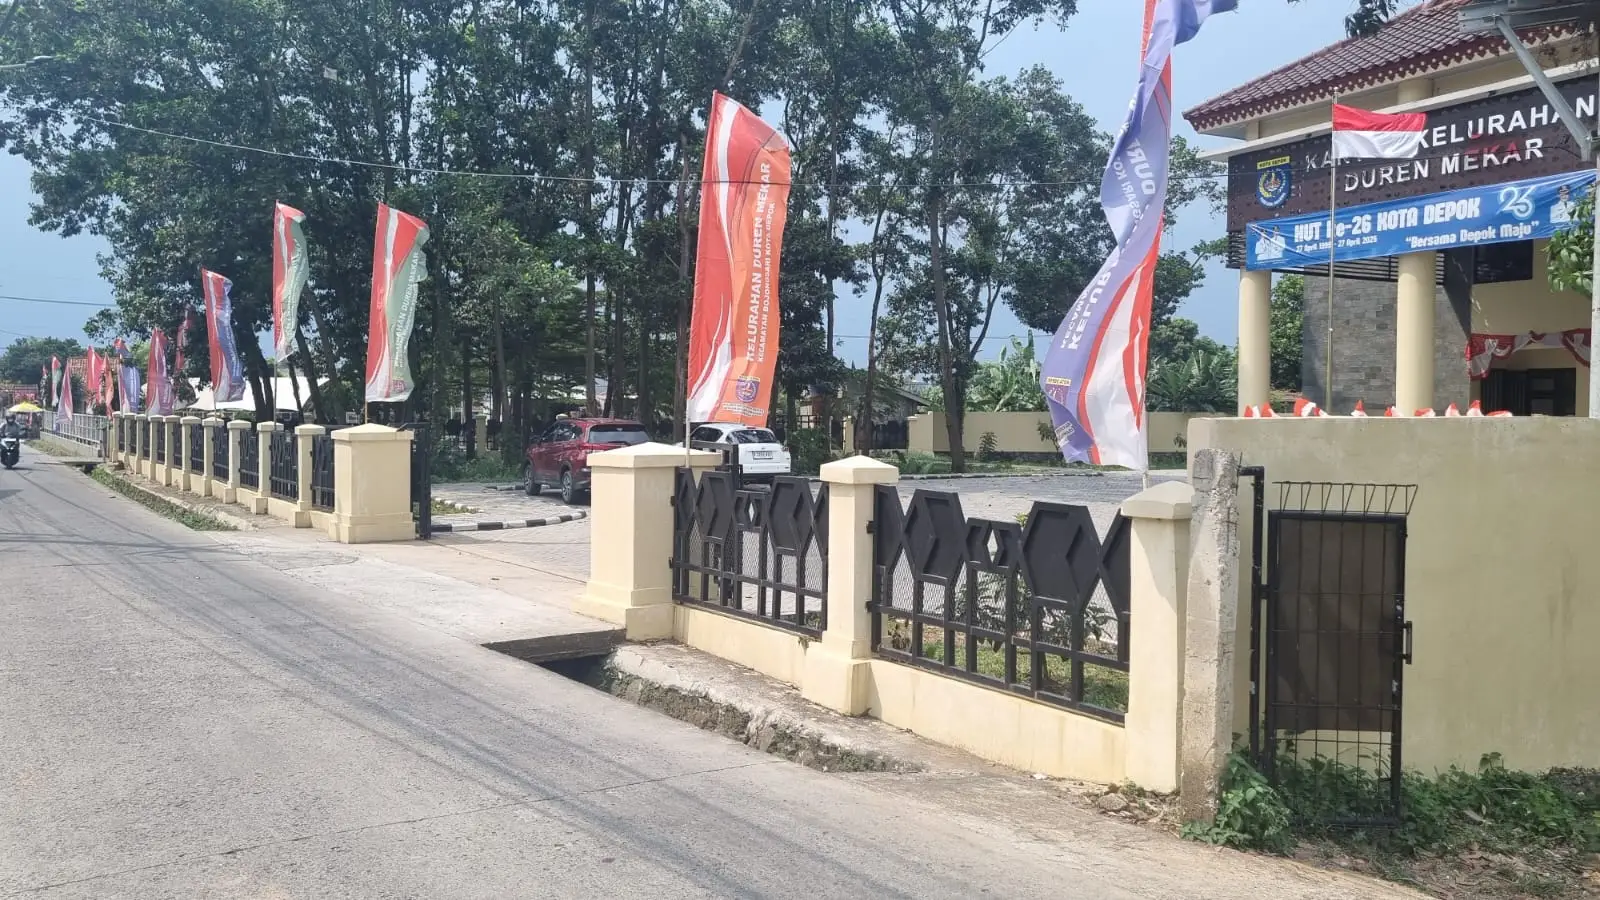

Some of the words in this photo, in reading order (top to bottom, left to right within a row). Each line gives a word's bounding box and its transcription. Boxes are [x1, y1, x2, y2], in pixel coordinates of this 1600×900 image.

[756, 162, 771, 213] MEKAR
[1345, 159, 1429, 192] DUREN
[1441, 138, 1543, 175] MEKAR
[752, 217, 763, 268] DUREN
[1294, 222, 1322, 242] HUT
[1377, 207, 1418, 231] KOTA
[1424, 198, 1481, 225] DEPOK
[1338, 239, 1345, 247] 27
[1347, 237, 1360, 247] April
[1460, 226, 1496, 243] Depok
[758, 315, 768, 362] KECAMATAN
[766, 202, 775, 230] DEPOK
[746, 272, 762, 361] KELURAHAN
